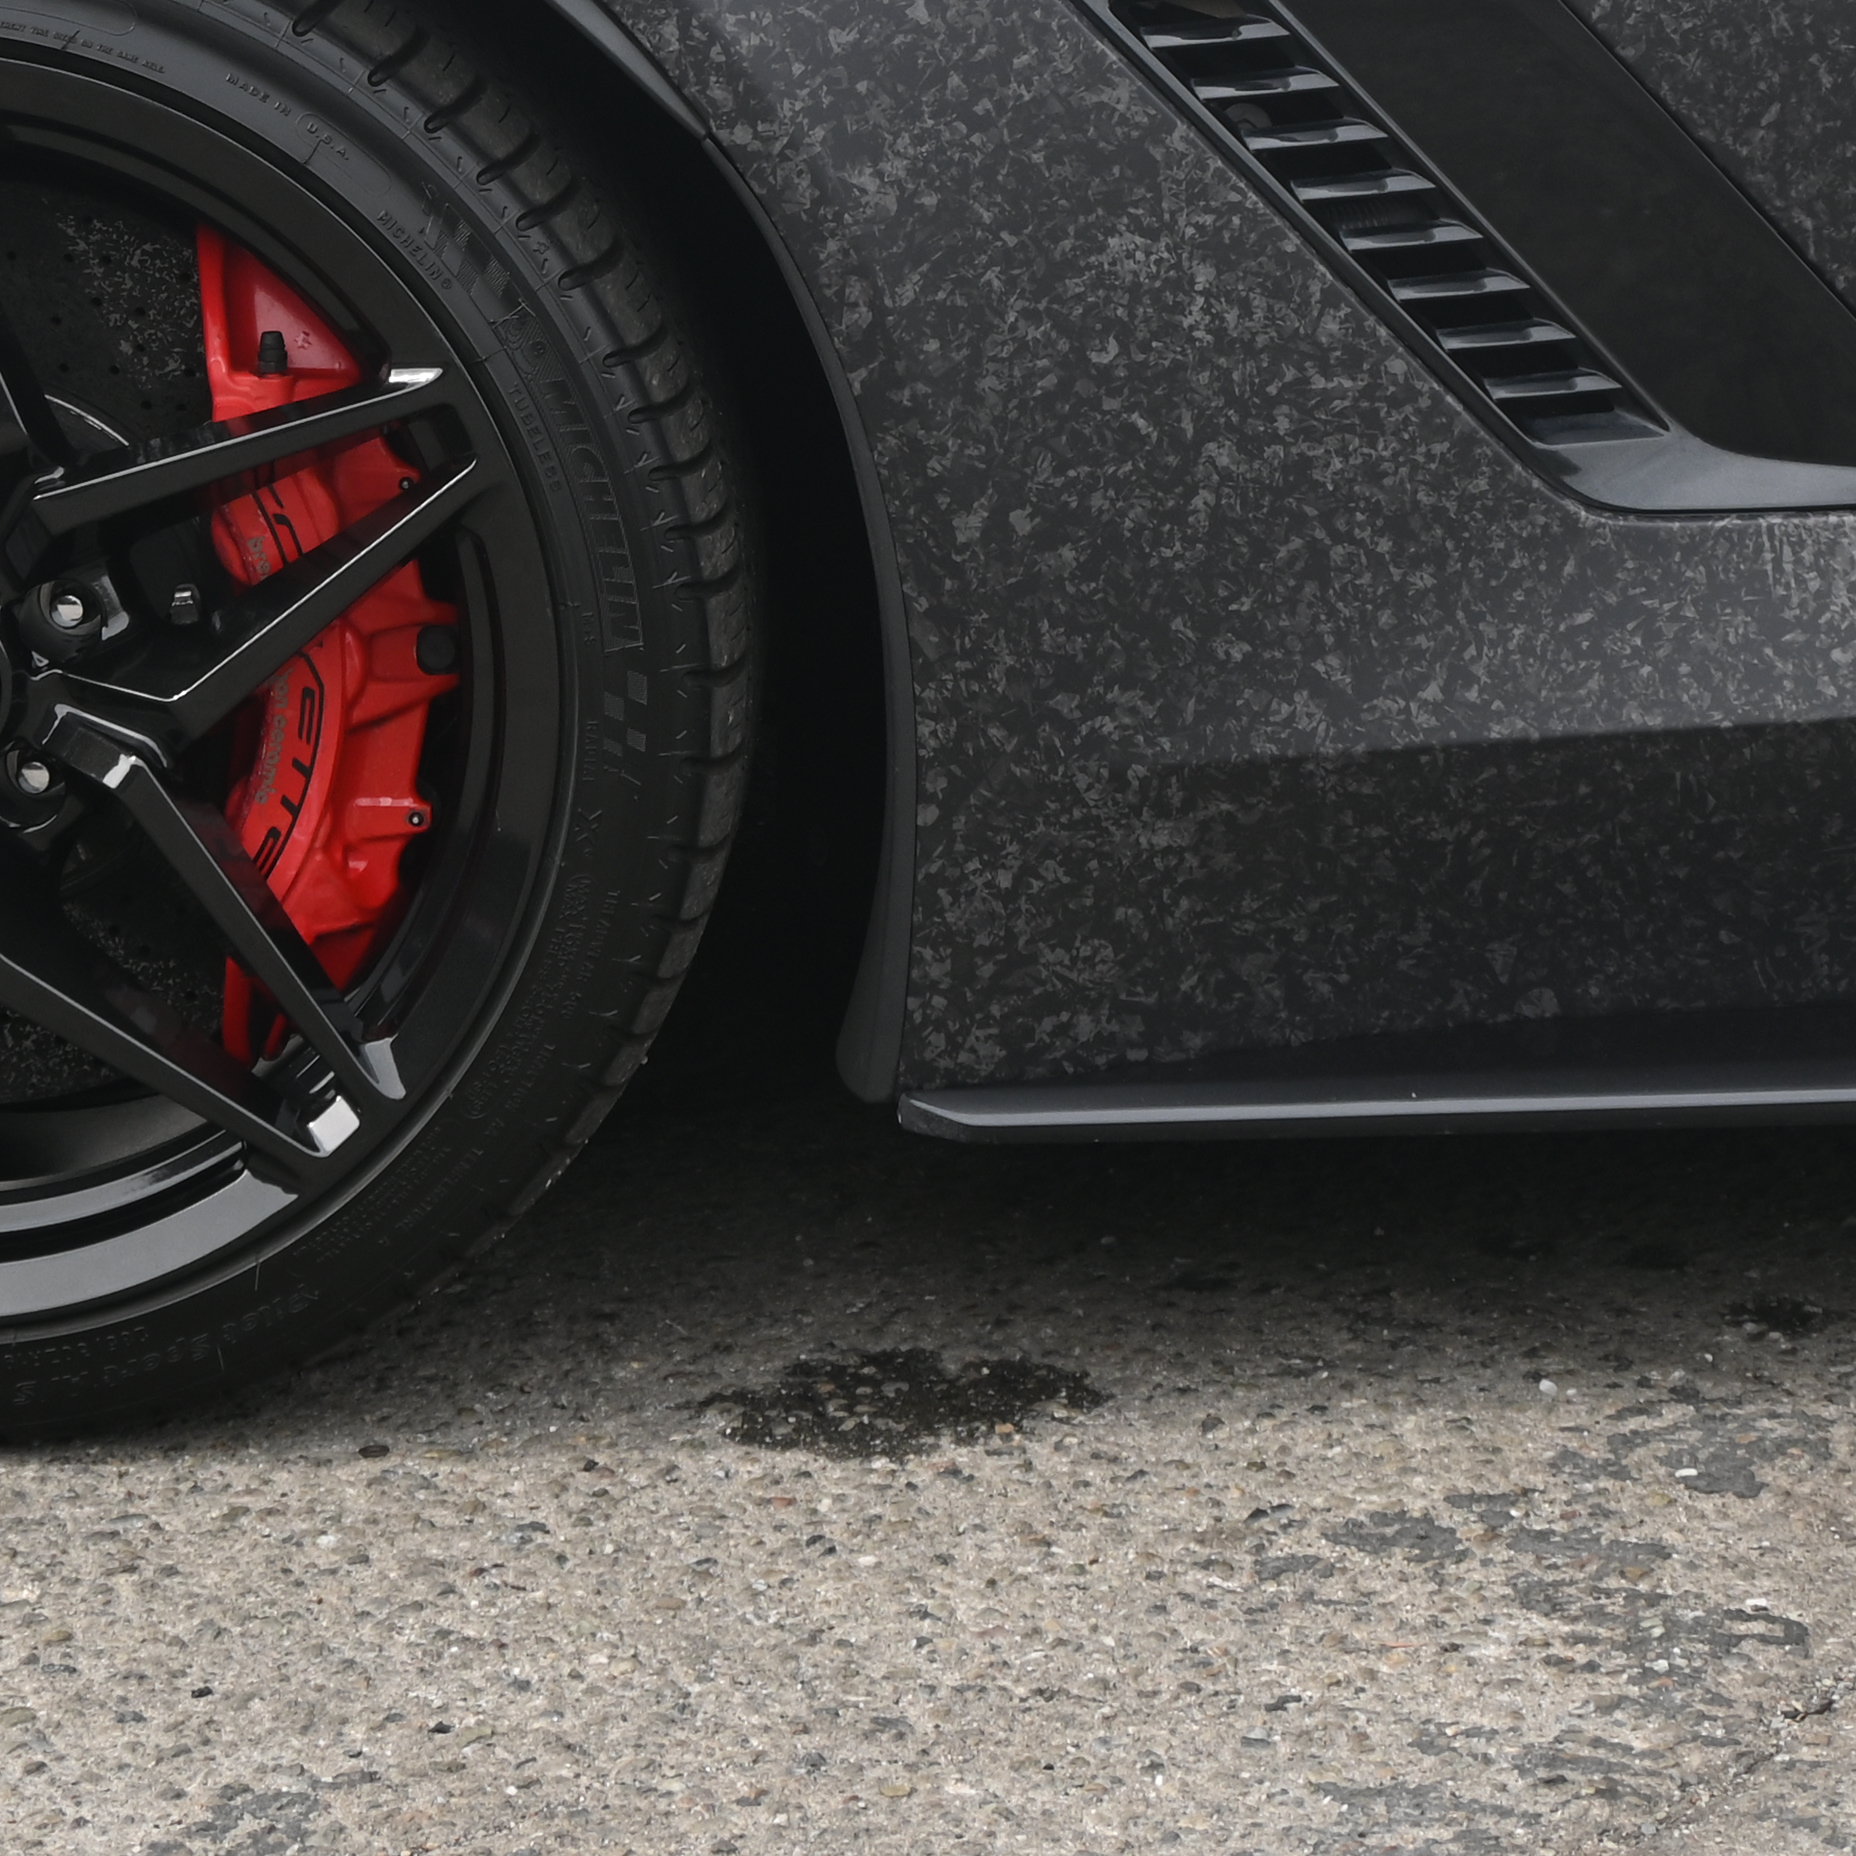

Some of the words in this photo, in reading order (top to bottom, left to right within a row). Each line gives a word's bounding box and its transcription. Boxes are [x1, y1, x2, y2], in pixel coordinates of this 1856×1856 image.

[224, 73, 270, 105] MADE
[273, 100, 293, 118] IN
[305, 121, 351, 161] U.S.A.
